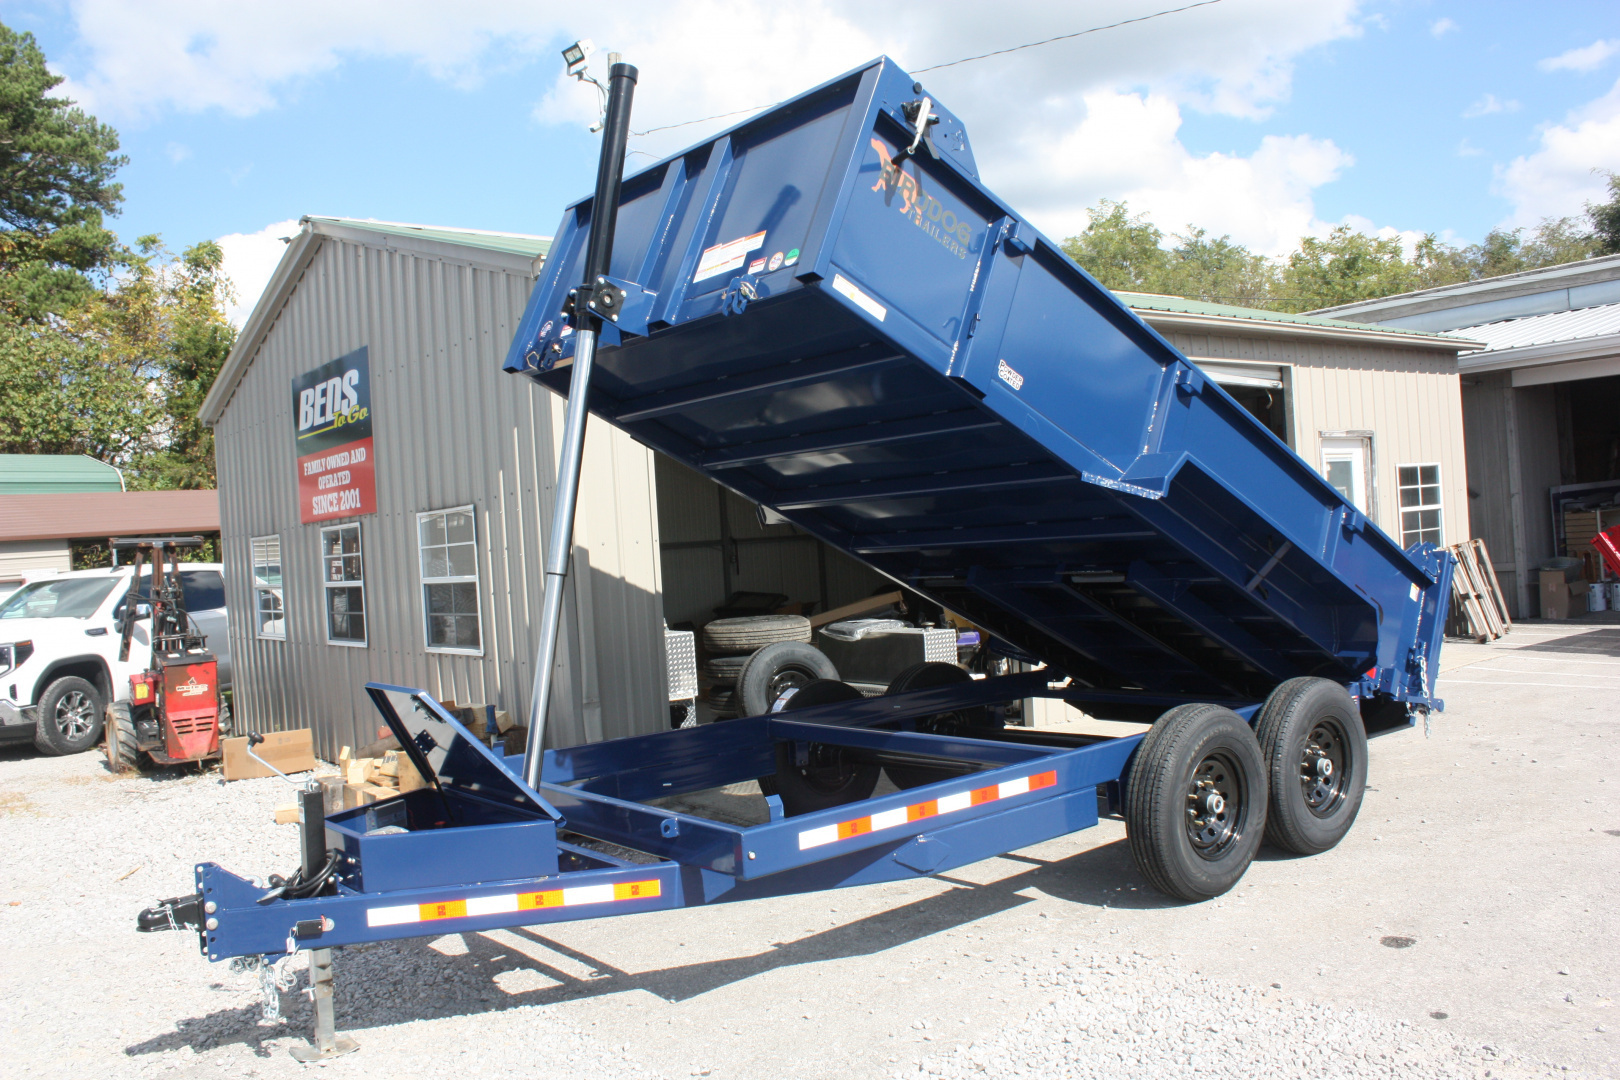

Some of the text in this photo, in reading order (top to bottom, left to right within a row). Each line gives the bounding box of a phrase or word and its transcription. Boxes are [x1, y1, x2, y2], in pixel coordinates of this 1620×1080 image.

[907, 207, 968, 260] TRAILERS
[999, 370, 1019, 389] COATED
[1000, 362, 1022, 383] POWDER
[298, 368, 359, 431] BEDS
[332, 404, 369, 429] To Go
[304, 448, 366, 476] FAMILY OWNED AND
[318, 470, 351, 490] OPERATED
[312, 487, 361, 516] SINCE 2001
